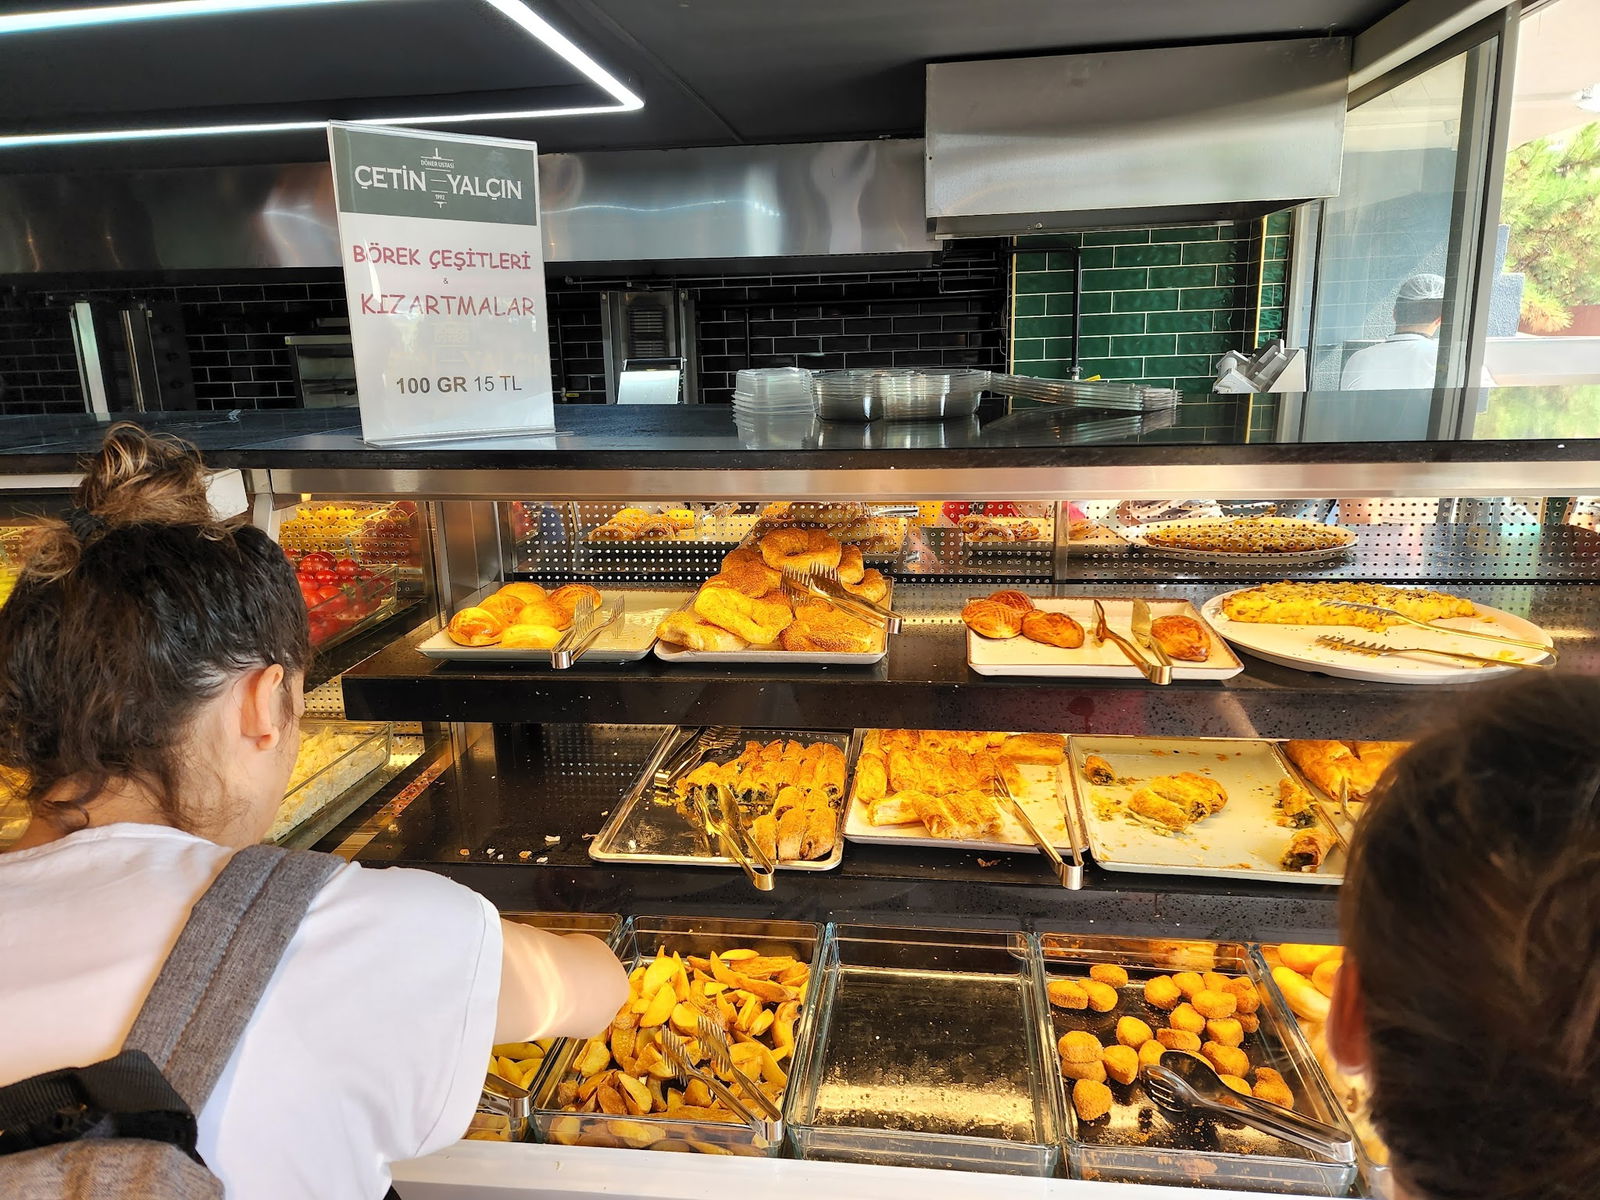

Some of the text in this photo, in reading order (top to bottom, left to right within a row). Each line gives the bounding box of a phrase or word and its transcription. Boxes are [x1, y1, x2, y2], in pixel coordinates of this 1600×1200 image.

[420, 159, 454, 169] DÖNER USTASI
[354, 165, 522, 200] ÇETİN YALÇIN
[353, 242, 531, 271] BÖREK ÇEŞİTLERİ
[443, 277, 449, 285] &
[361, 293, 535, 316] KIZARTMALAR
[396, 375, 522, 394] 100 GR 15 TL
